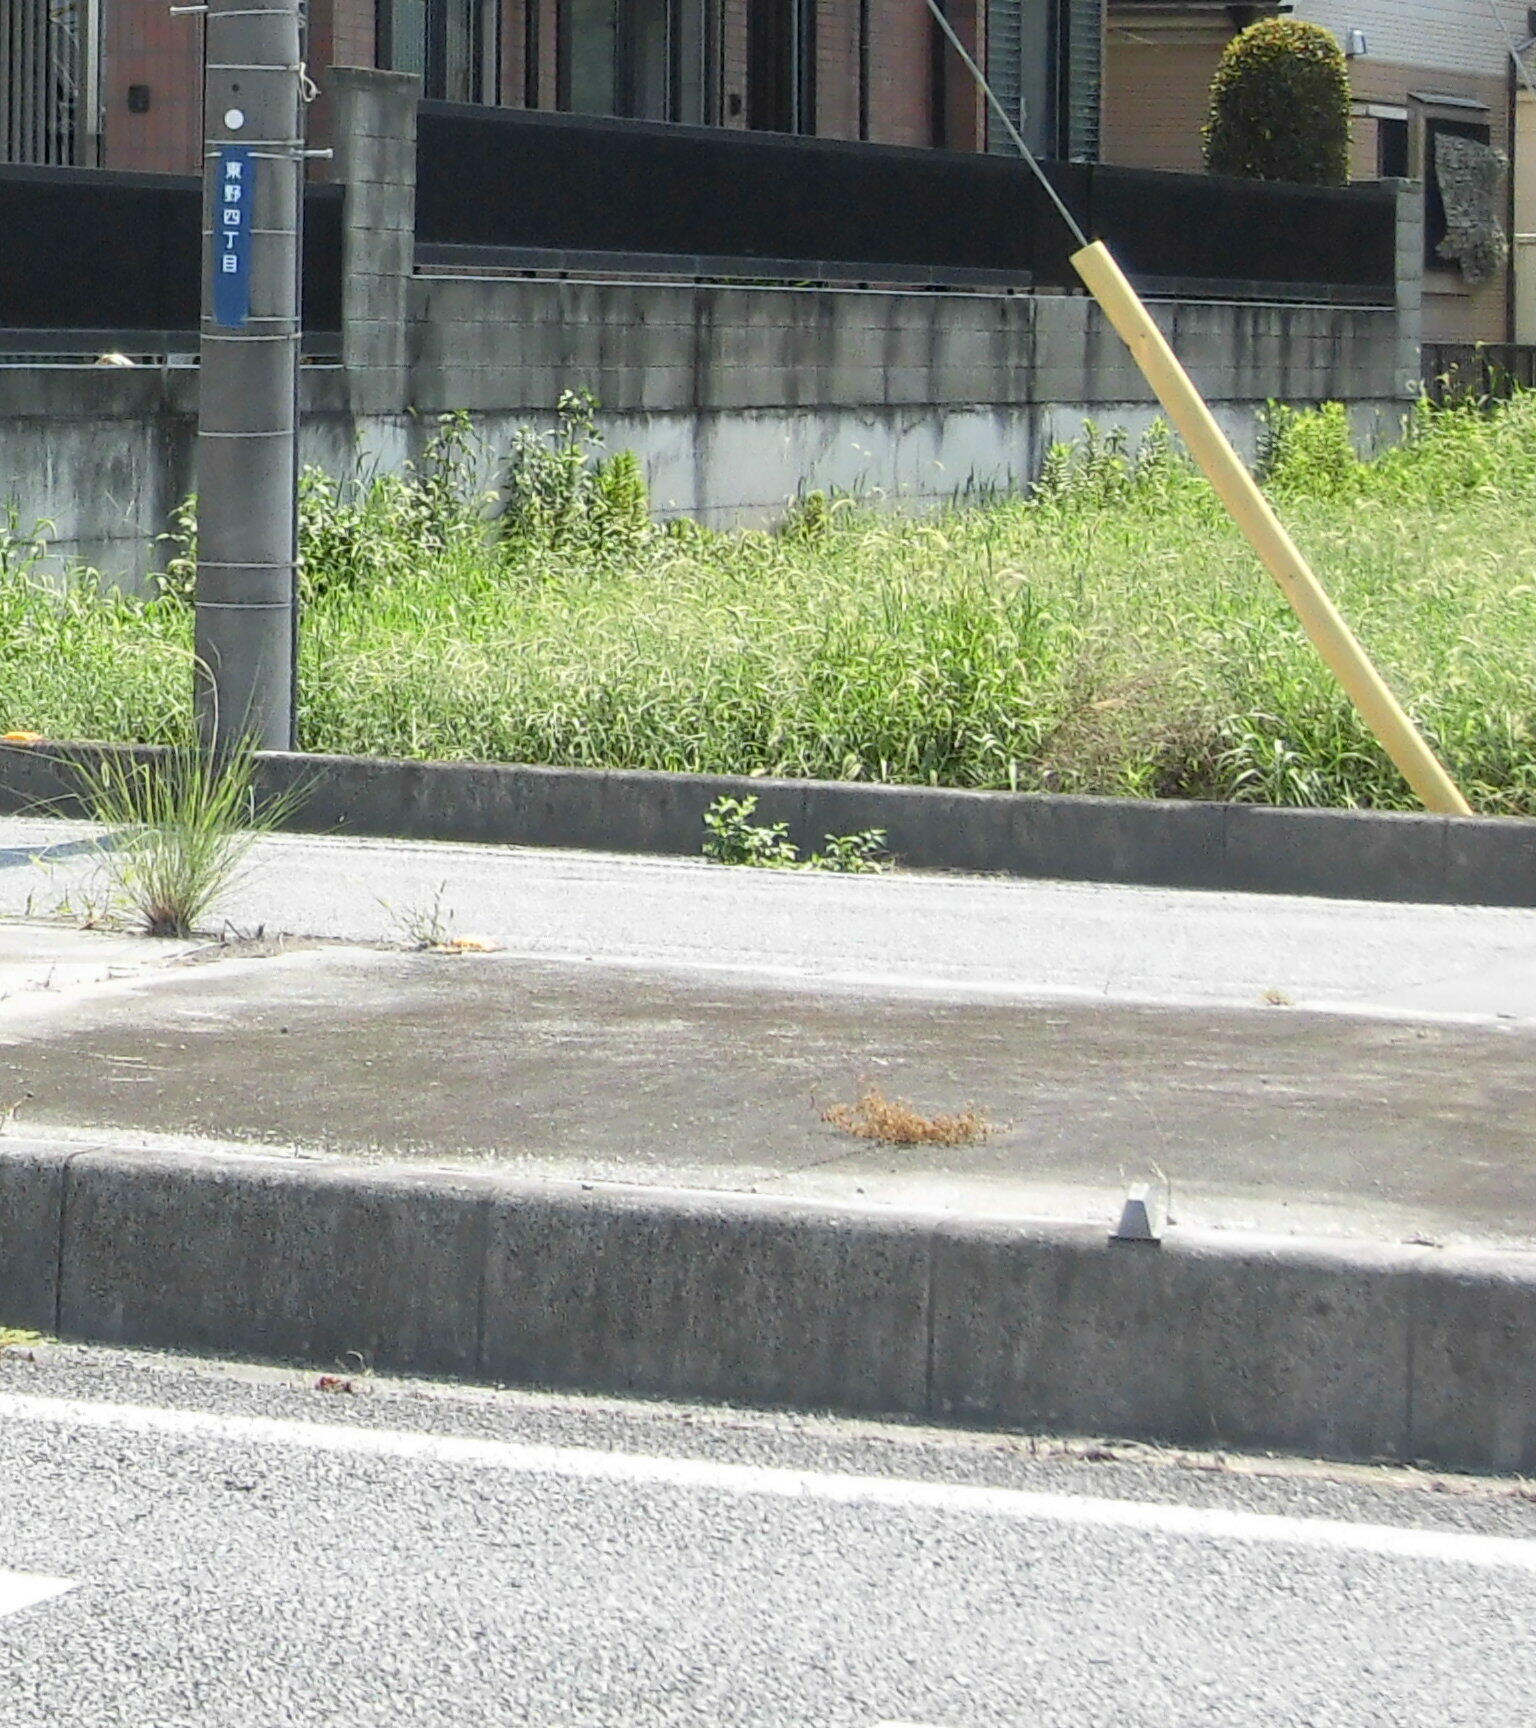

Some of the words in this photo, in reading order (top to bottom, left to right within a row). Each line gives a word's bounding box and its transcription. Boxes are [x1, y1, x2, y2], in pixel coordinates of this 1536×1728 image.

[222, 161, 243, 273] 東野四丁目
